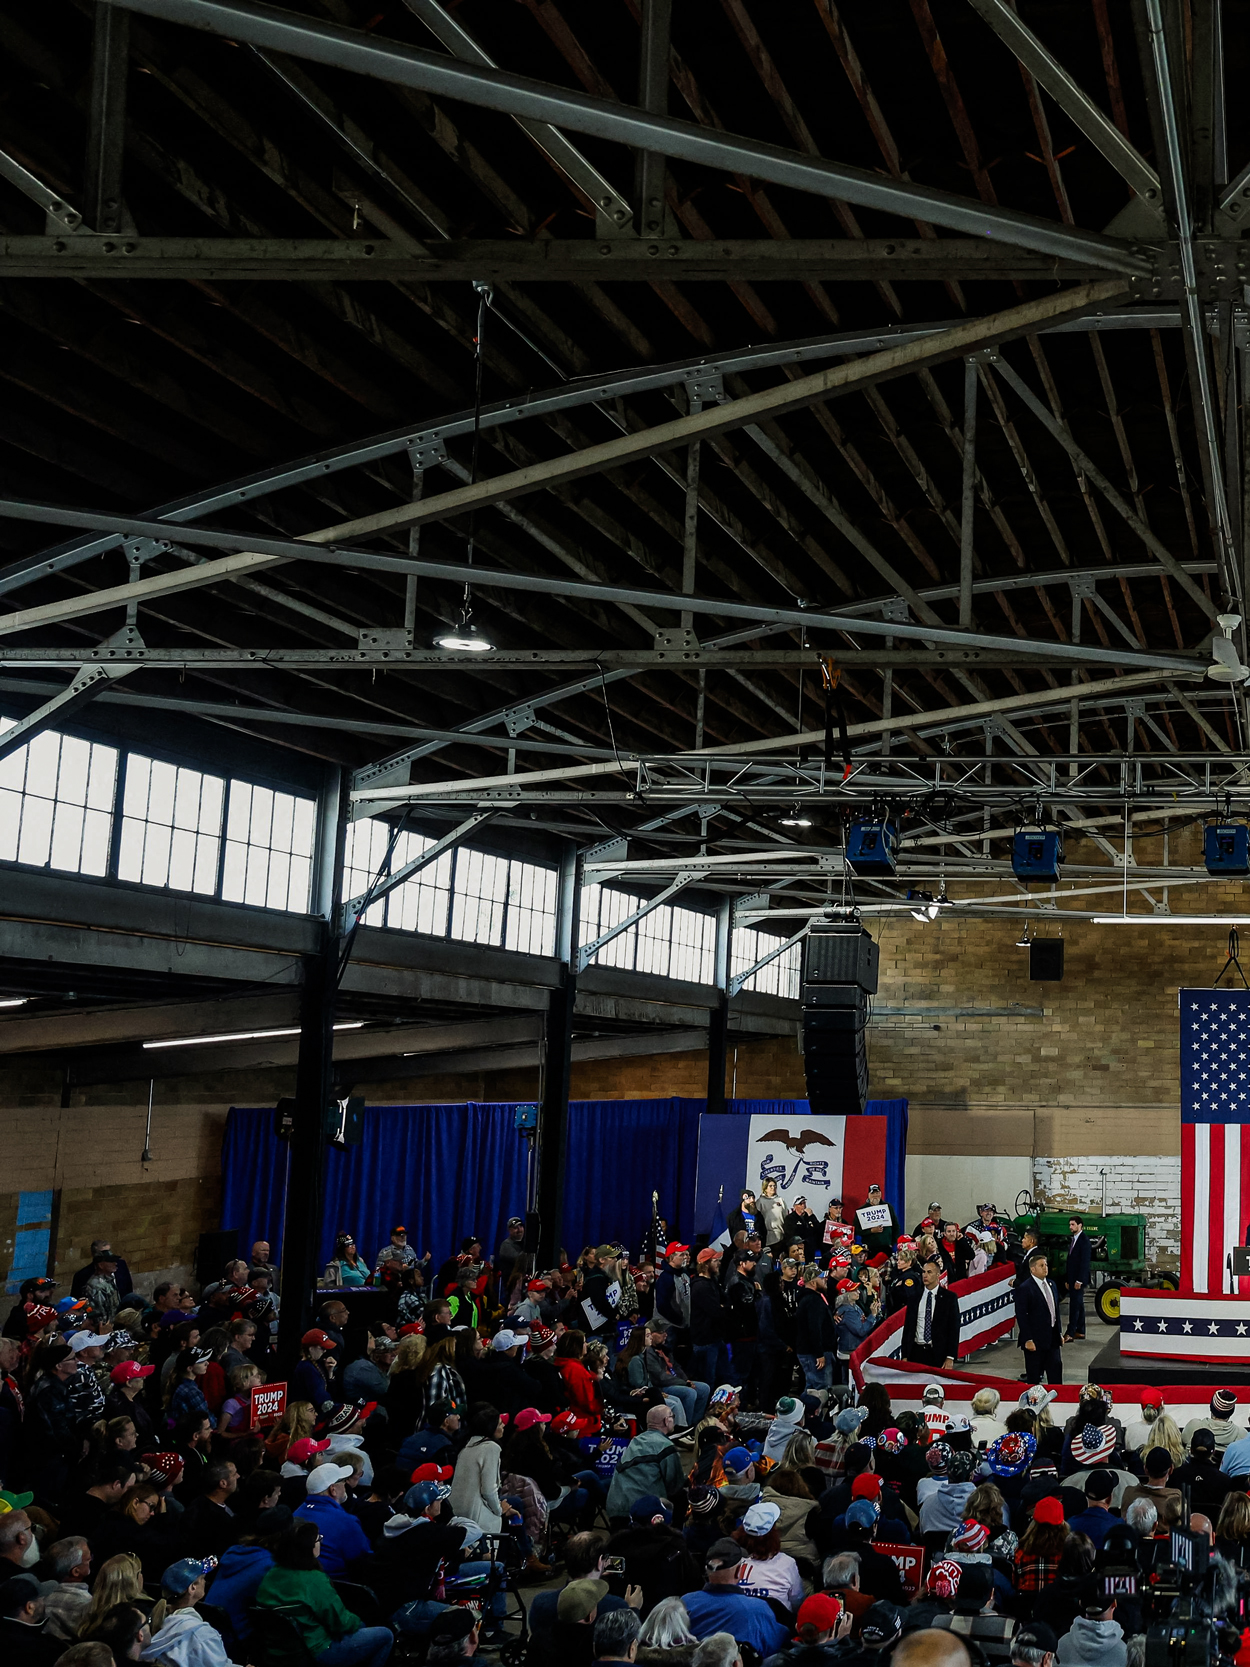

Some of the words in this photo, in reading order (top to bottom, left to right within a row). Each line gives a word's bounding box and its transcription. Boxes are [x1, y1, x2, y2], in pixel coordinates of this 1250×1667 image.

[861, 1208, 887, 1218] TRUMP
[866, 1214, 885, 1222] 2024
[254, 1390, 283, 1405] TRUMP
[257, 1401, 279, 1415] 2024
